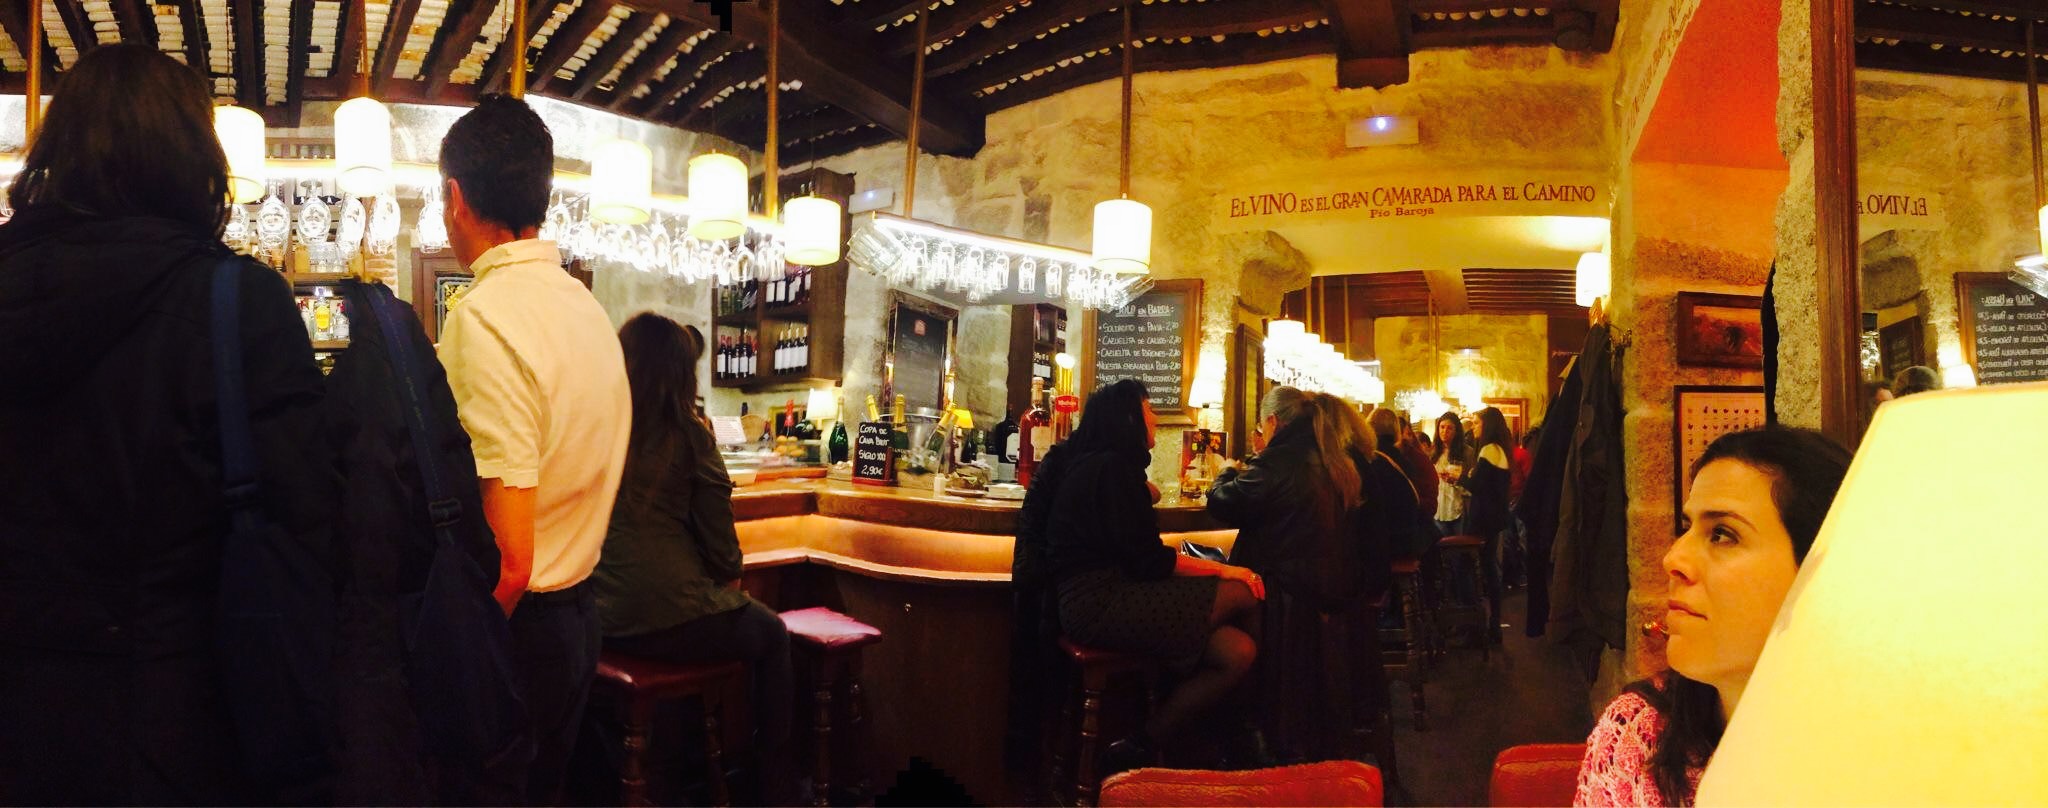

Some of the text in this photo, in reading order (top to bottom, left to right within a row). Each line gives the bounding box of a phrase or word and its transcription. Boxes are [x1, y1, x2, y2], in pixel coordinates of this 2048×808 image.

[1248, 192, 1296, 215] VINO
[1300, 198, 1316, 213] ES
[1316, 197, 1330, 211] EL
[1332, 191, 1369, 209] GRAN
[1372, 186, 1453, 207] CAMARADA
[1457, 184, 1497, 202] PARA
[1502, 186, 1519, 201] EL
[1523, 182, 1596, 203] CAMINO
[1395, 206, 1434, 217] Baroja
[860, 424, 877, 434] COPA
[858, 449, 876, 460] SIGLO
